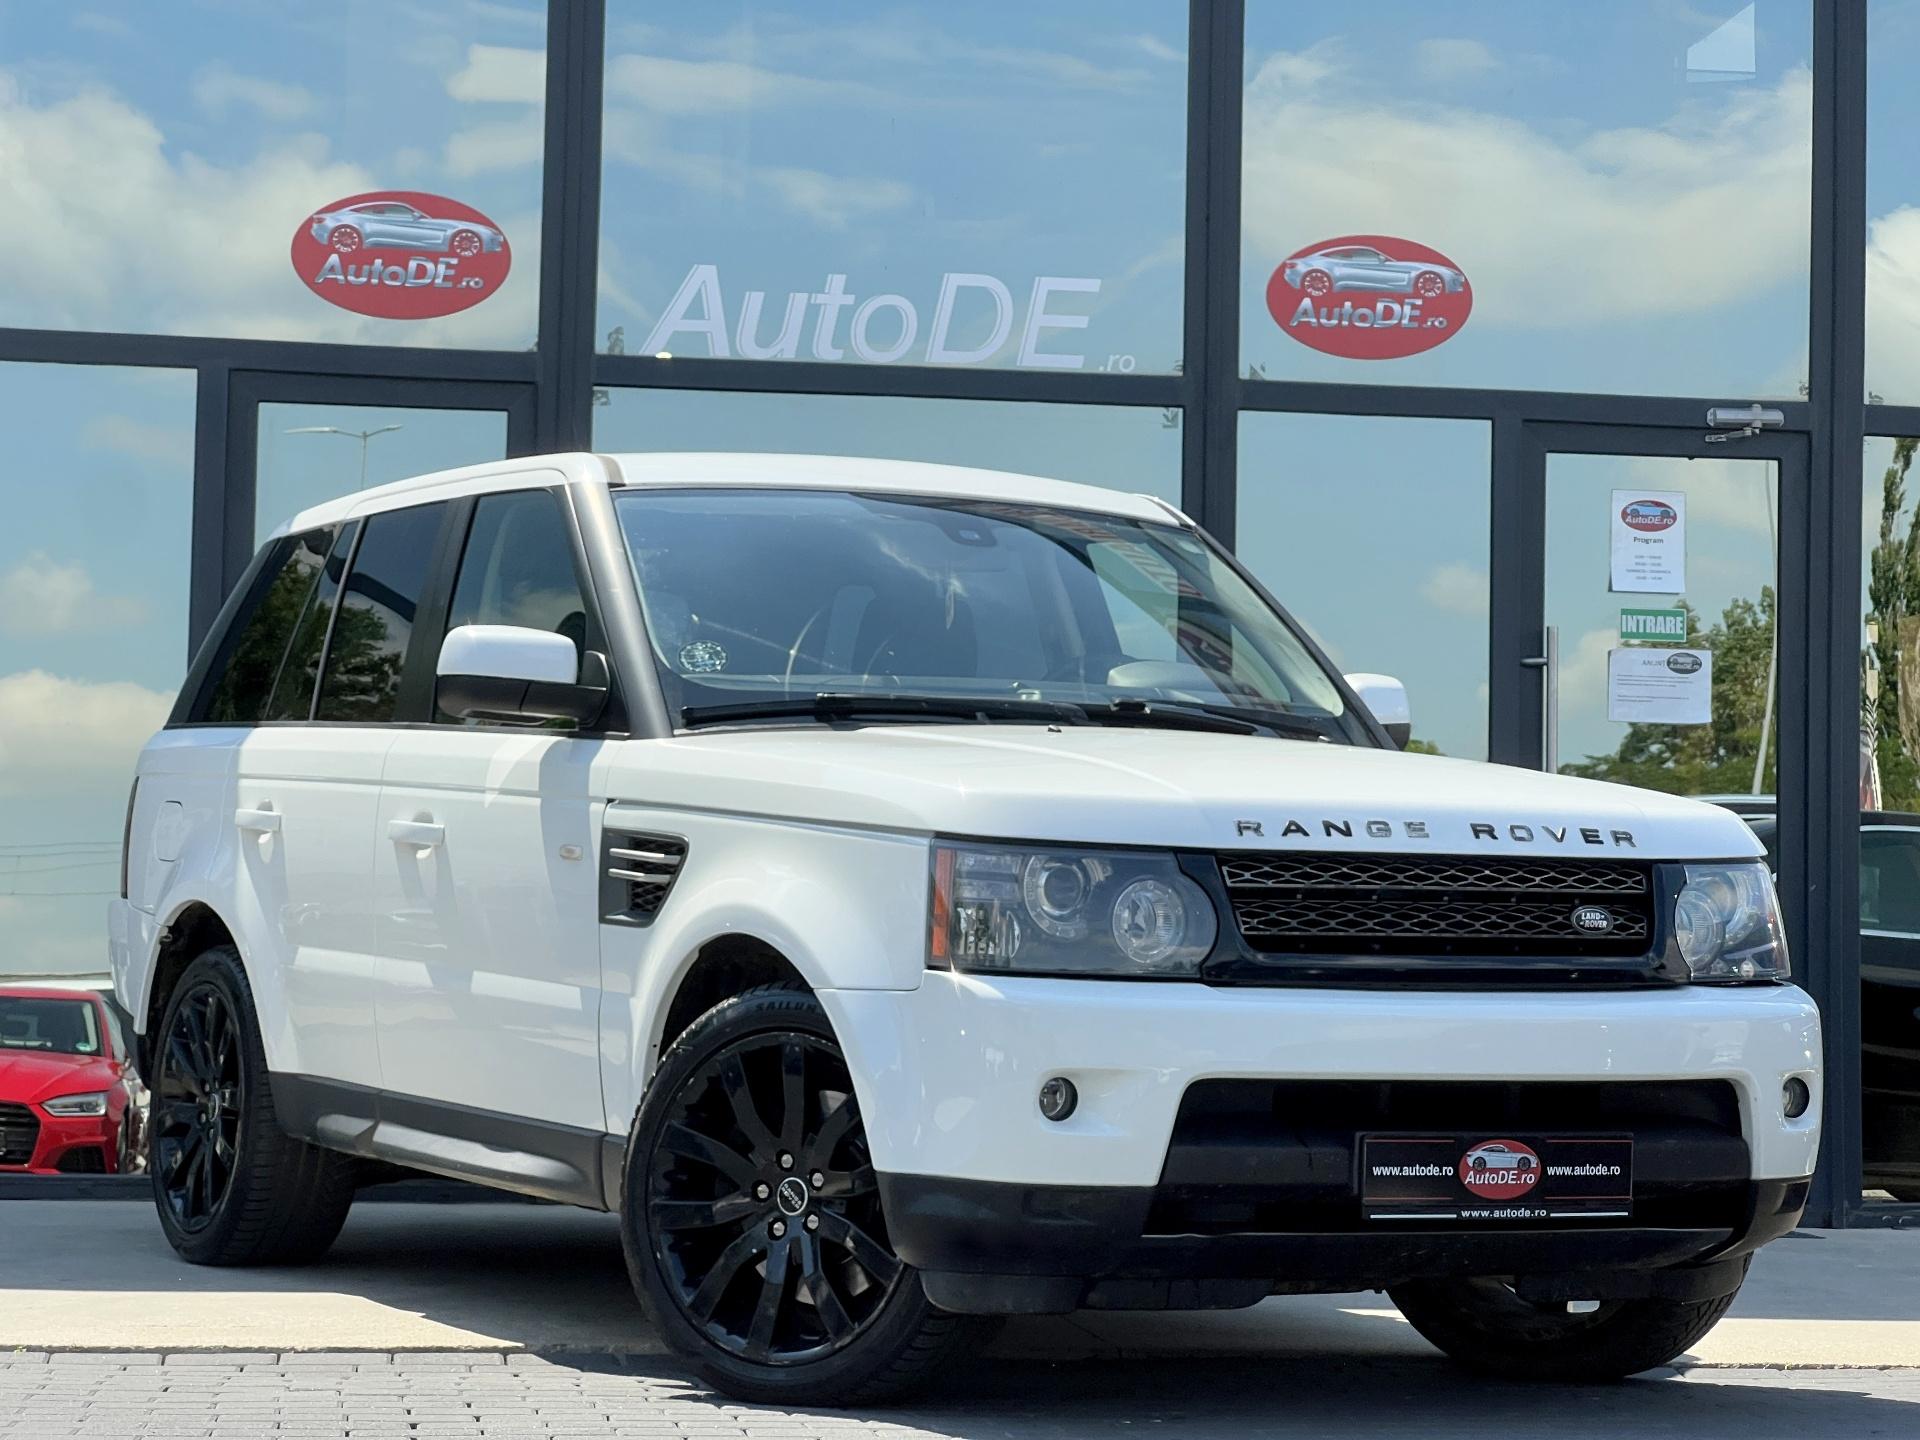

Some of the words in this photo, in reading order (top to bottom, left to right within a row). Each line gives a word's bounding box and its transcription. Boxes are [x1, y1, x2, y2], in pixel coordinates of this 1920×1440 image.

[1633, 536, 1664, 545] Program
[1621, 614, 1684, 634] INTRARE
[1232, 819, 1430, 838] RANGE
[1469, 822, 1637, 848] ROVER
[1581, 912, 1601, 920] LAND
[1584, 920, 1608, 928] ROVER
[1372, 1163, 1454, 1176] www.autode.ro
[1547, 1163, 1621, 1176] www.autode.ro
[1464, 1170, 1536, 1185] AutoDE.ro
[1460, 1207, 1547, 1218] www.autode.ro
